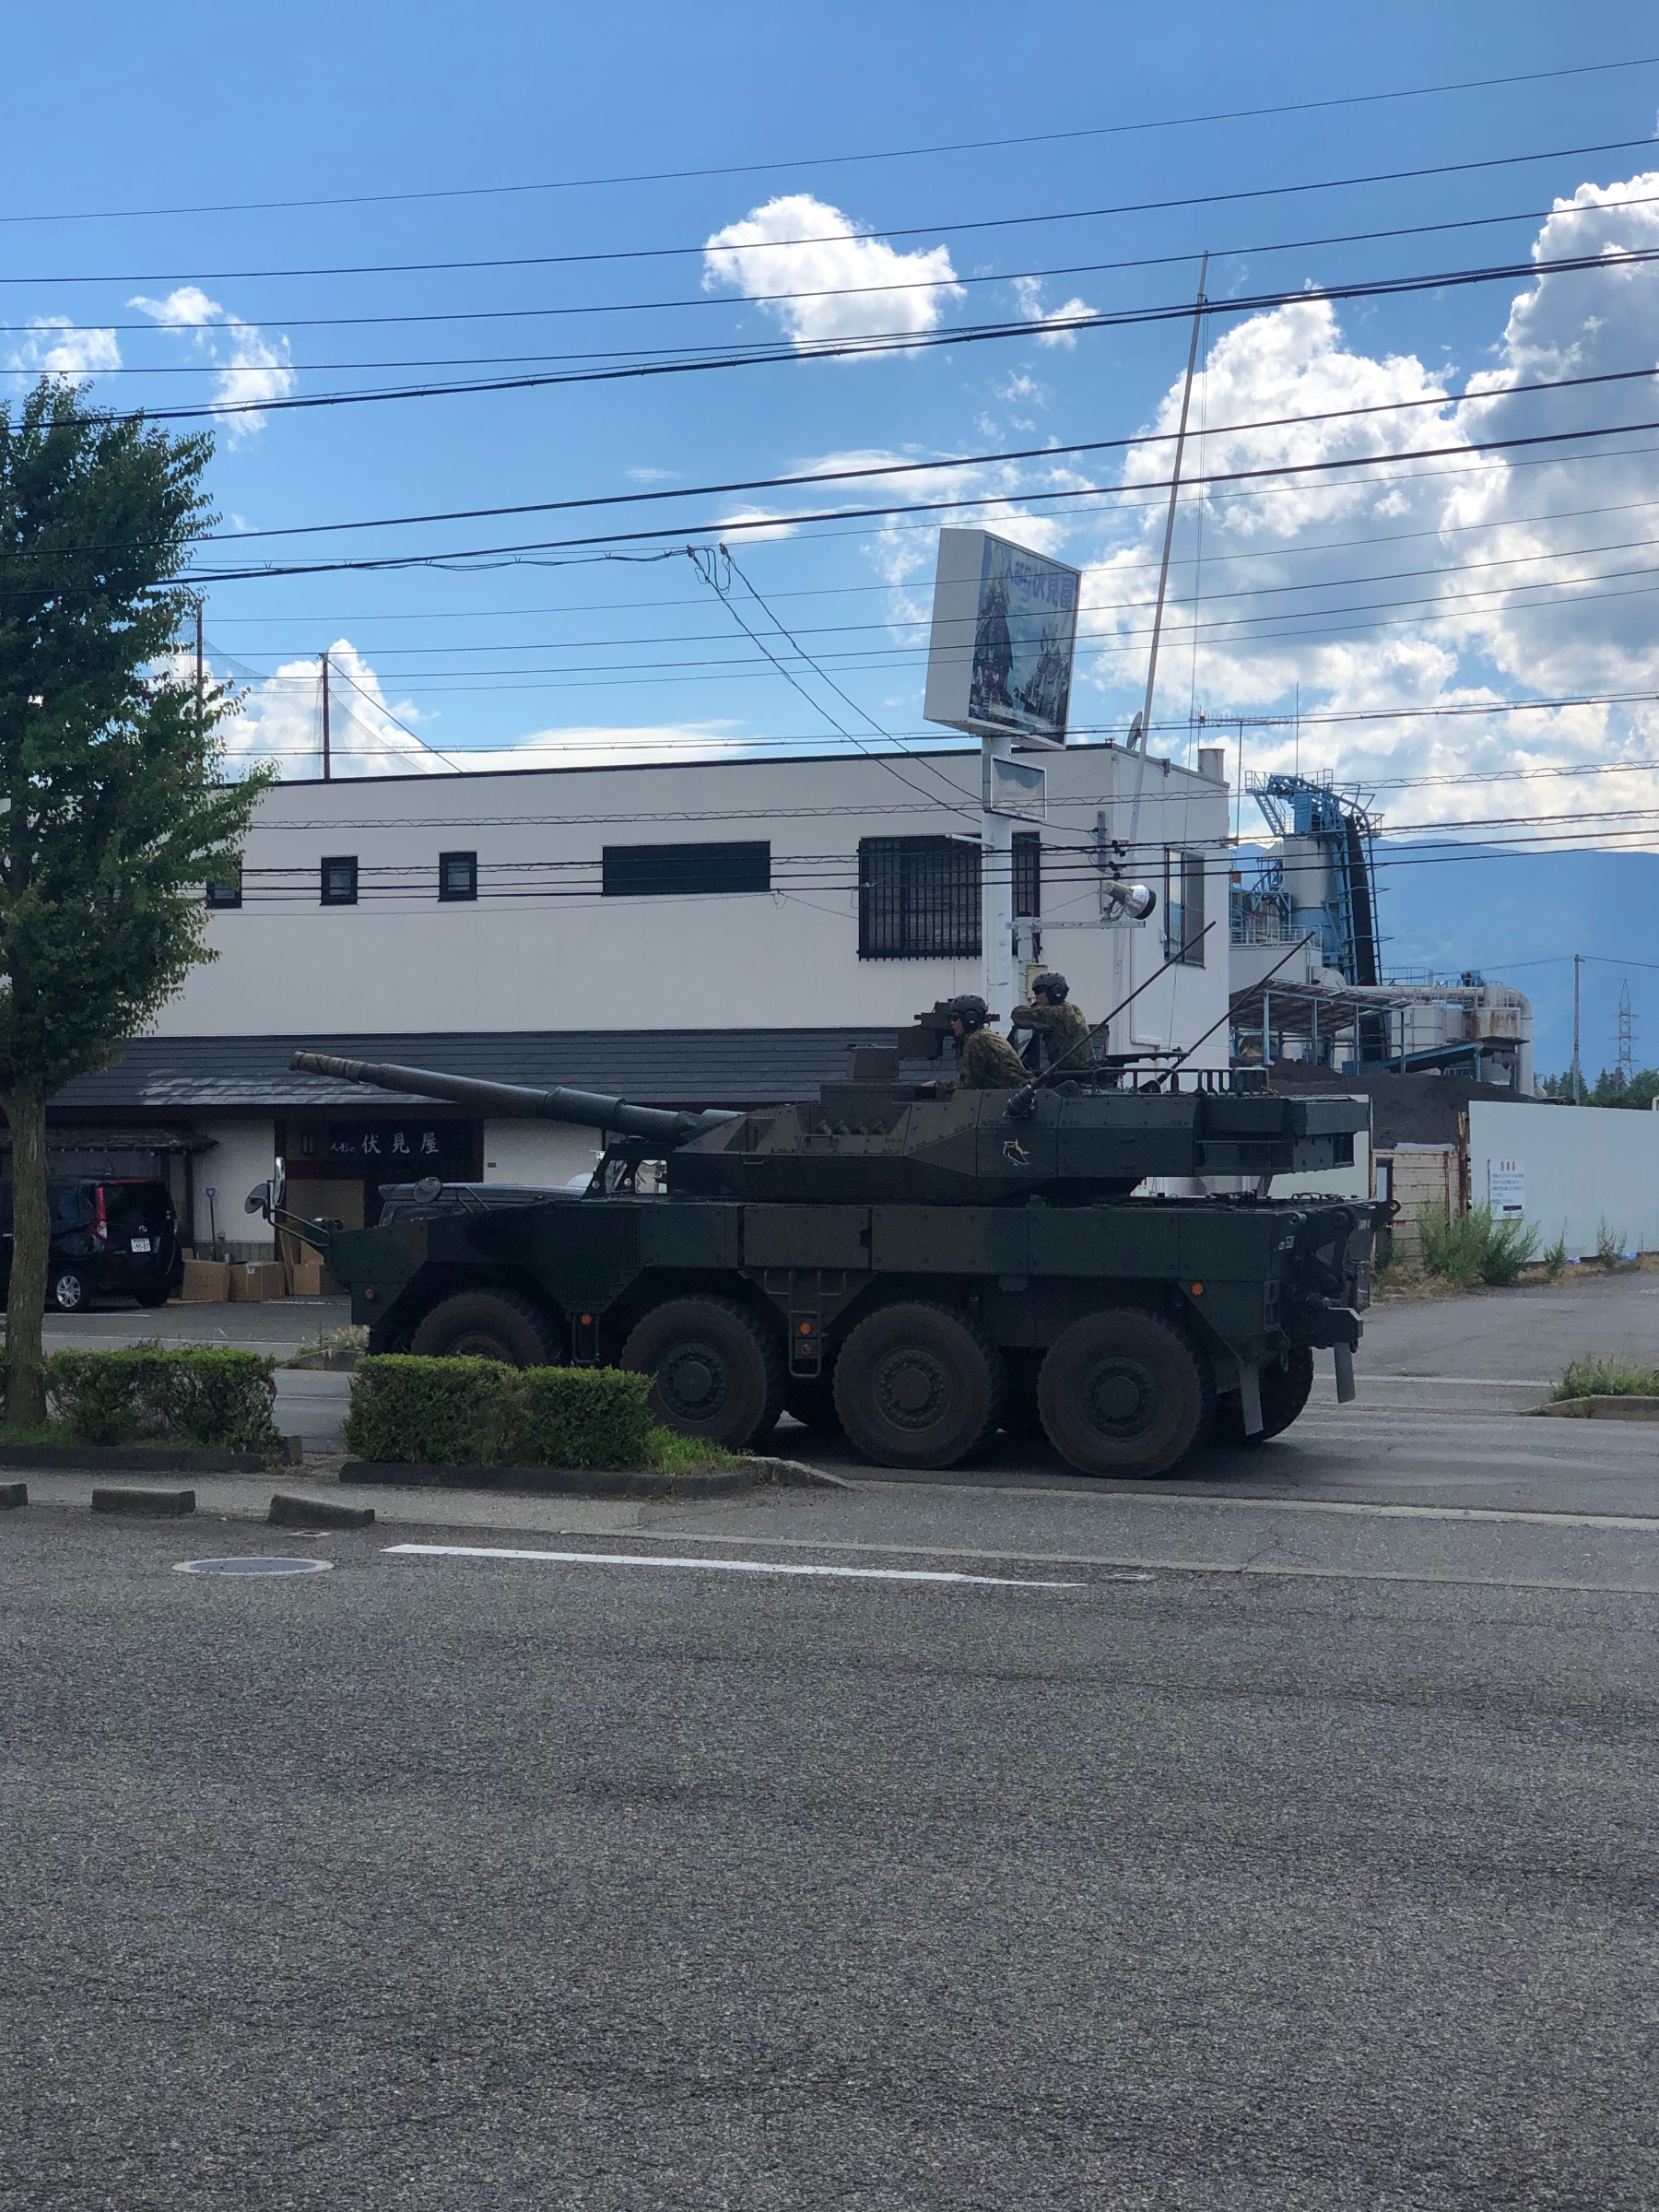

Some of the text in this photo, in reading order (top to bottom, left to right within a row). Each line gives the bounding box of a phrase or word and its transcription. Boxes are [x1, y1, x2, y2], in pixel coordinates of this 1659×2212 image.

[330, 1131, 440, 1155] 人形の伏見屋
